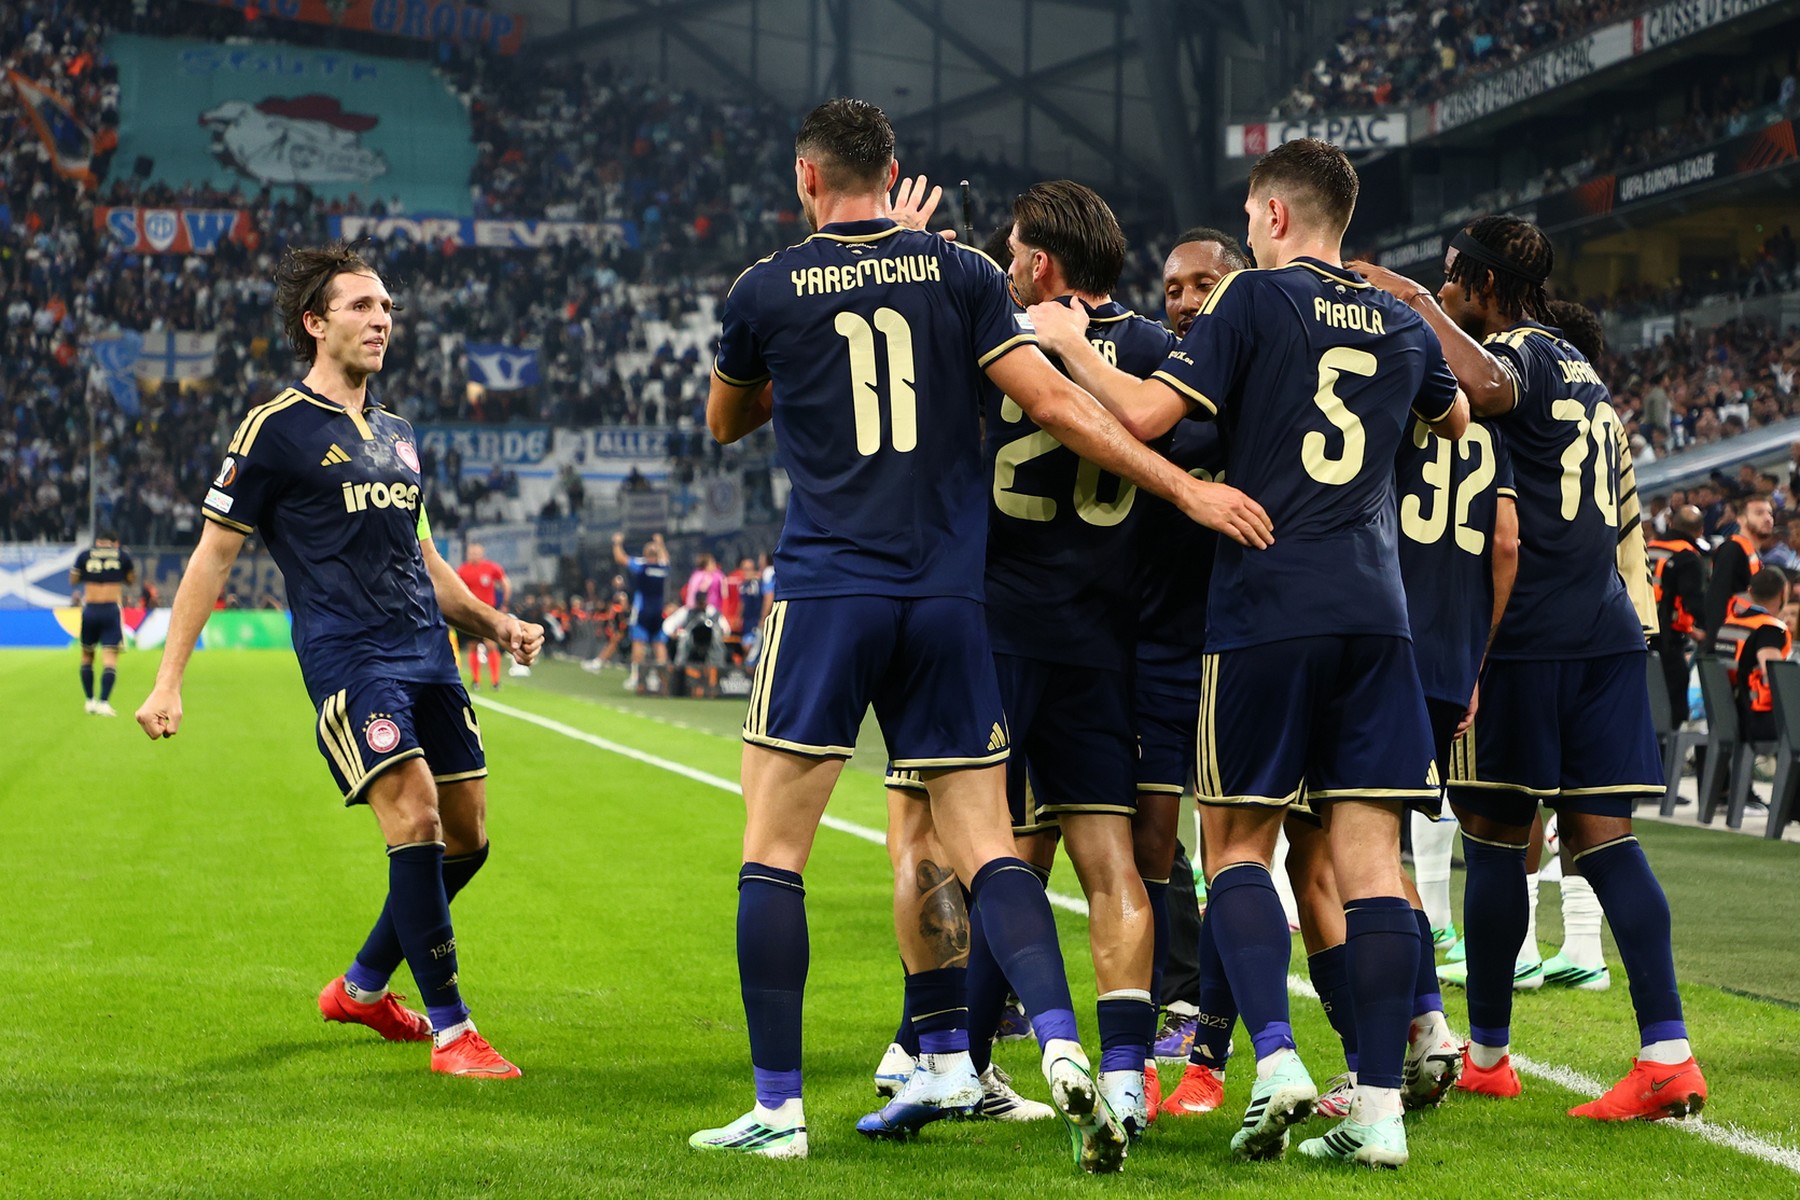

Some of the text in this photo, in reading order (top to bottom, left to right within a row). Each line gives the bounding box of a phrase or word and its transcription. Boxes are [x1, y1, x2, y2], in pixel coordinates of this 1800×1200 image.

[371, 0, 514, 51] GROUP
[1281, 116, 1389, 147] CEPAC
[791, 254, 941, 298] YAREMCHUK
[1313, 296, 1386, 335] PIROLA
[834, 306, 918, 457] 11
[1301, 346, 1379, 486] 5
[1400, 420, 1497, 556] 32
[1551, 398, 1618, 528] 70
[1198, 1011, 1230, 1029] 1925
